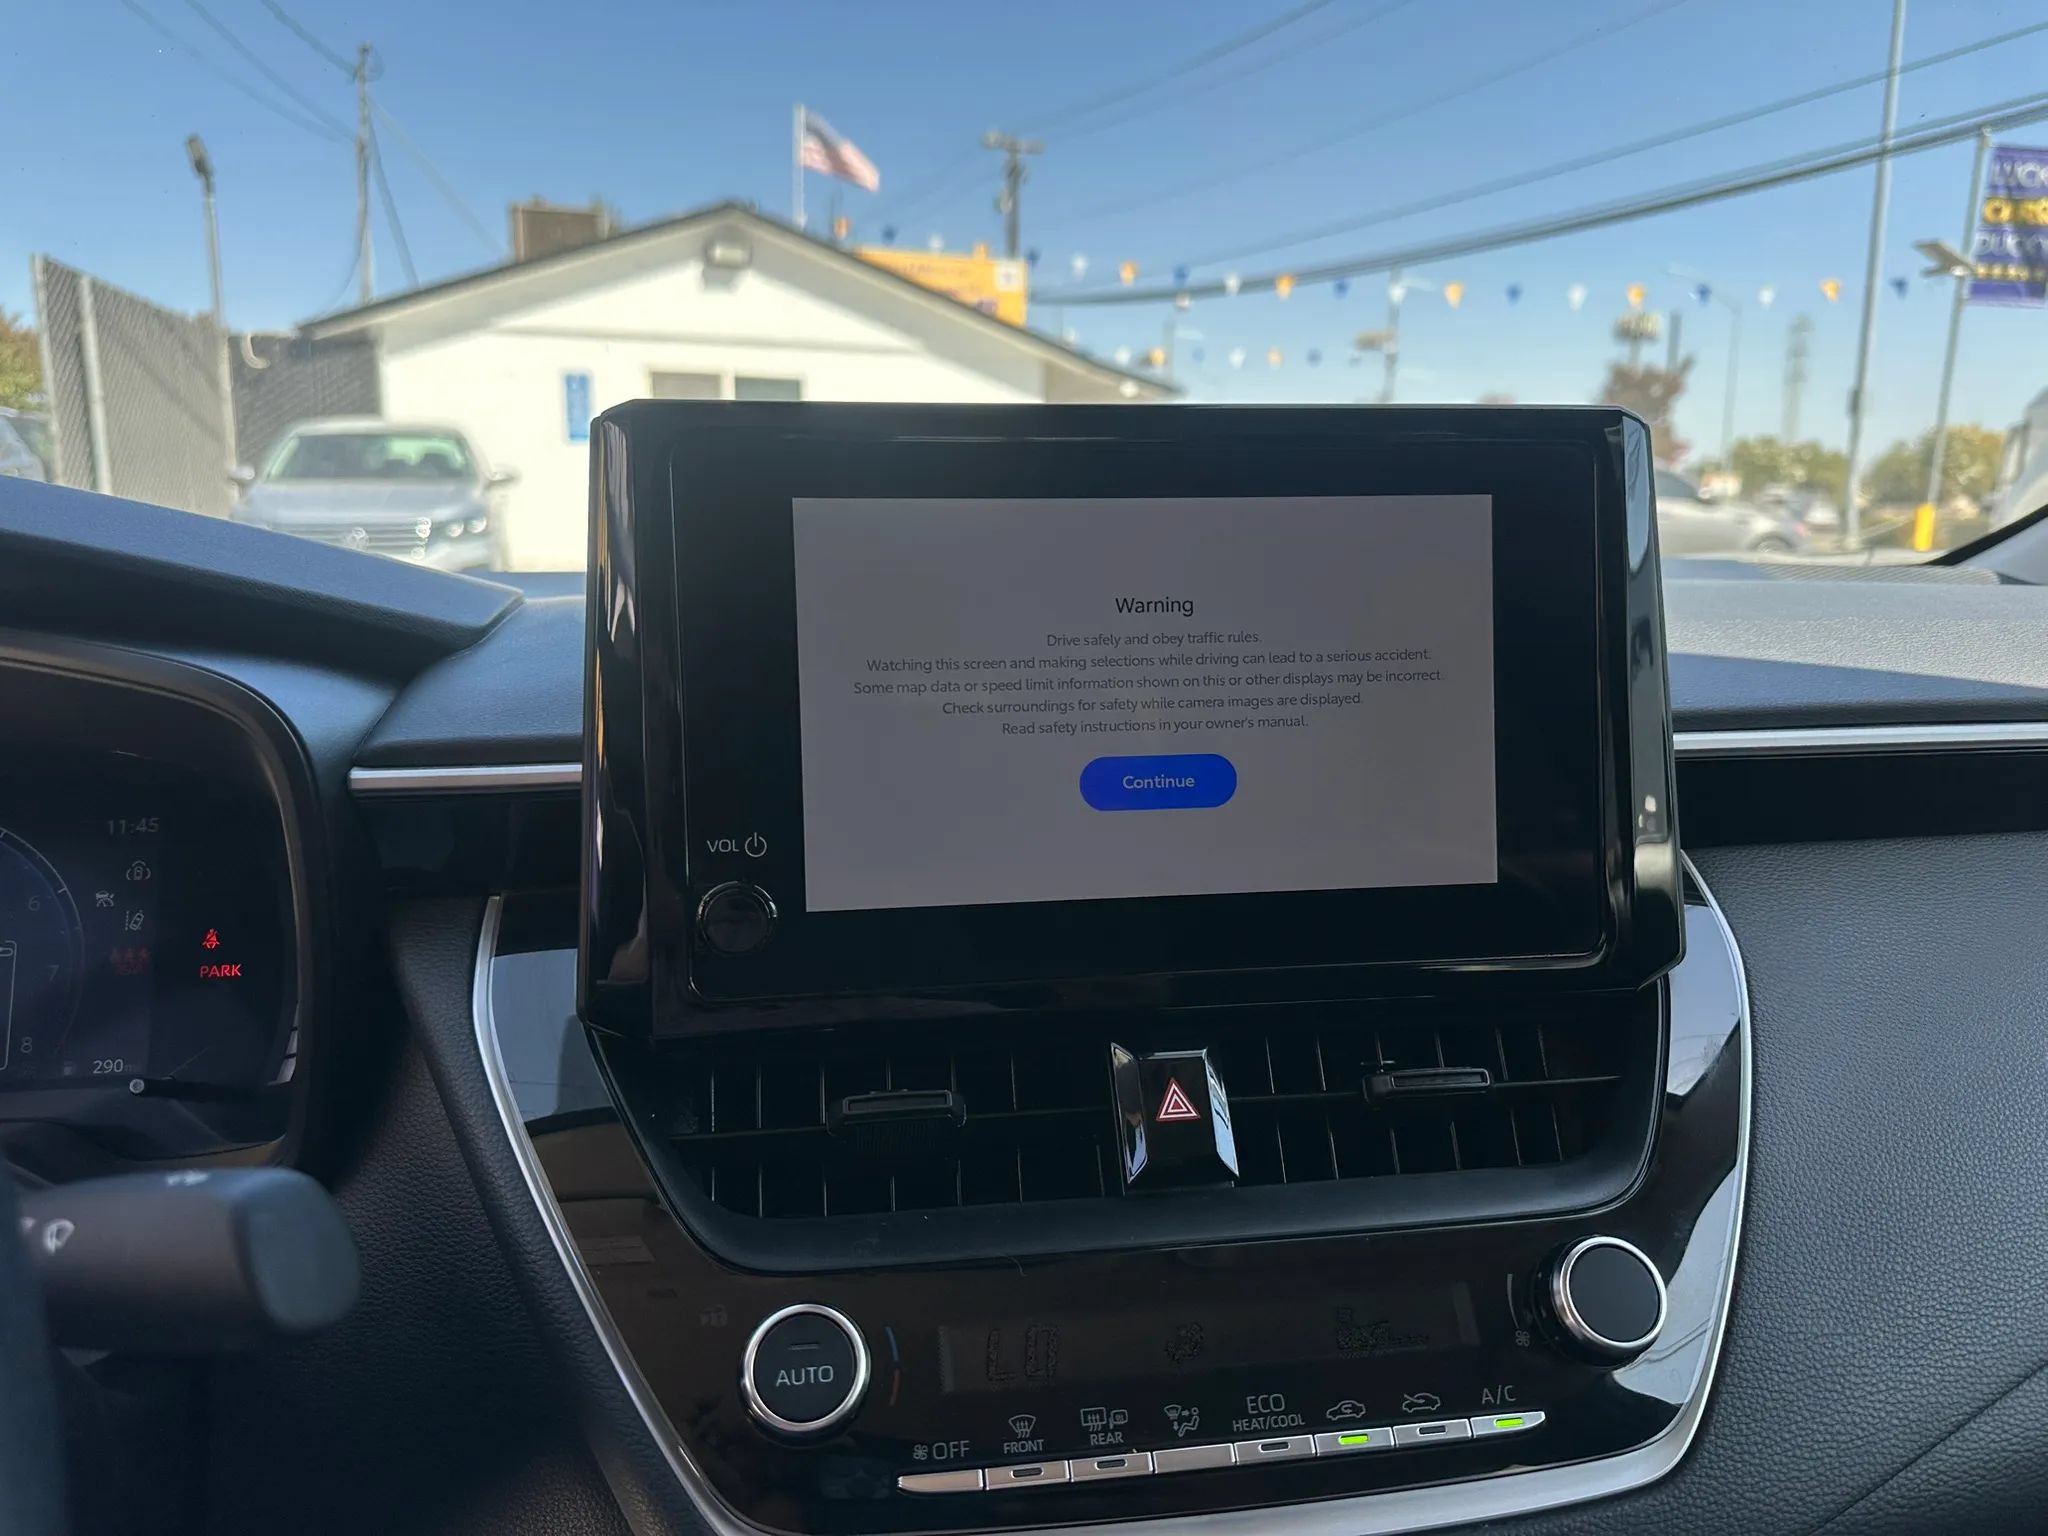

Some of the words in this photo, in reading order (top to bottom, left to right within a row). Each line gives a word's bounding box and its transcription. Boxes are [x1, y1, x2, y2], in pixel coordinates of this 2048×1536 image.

[1115, 596, 1195, 618] Warning
[1047, 634, 1081, 647] Drive
[1083, 633, 1121, 649] safely
[1125, 633, 1149, 646] and
[1152, 632, 1184, 648] obey
[1187, 631, 1225, 644] traffic
[1228, 630, 1262, 643] rules.
[866, 659, 932, 674] Watching
[936, 658, 960, 671] this
[963, 659, 1006, 670] screen
[1010, 657, 1035, 670] and
[1038, 656, 1087, 671] making
[1090, 655, 1155, 668] selections
[1158, 653, 1193, 667] while
[1195, 652, 1239, 668] driving
[1242, 654, 1265, 665] can
[1268, 651, 1296, 664] lead
[1300, 651, 1313, 664] to
[1316, 654, 1324, 663] a
[1327, 650, 1372, 663] serious
[1374, 648, 1431, 662] accident.
[854, 682, 894, 694] Some
[897, 683, 927, 696] map
[930, 680, 961, 693] data
[964, 682, 978, 692] or
[981, 679, 1022, 694] speed
[1025, 678, 1054, 691] limit
[1057, 677, 1133, 690] information
[1136, 676, 1179, 689] shown
[1182, 677, 1200, 687] on
[1203, 674, 1225, 687] this
[1228, 676, 1242, 686] or
[1246, 673, 1279, 686] other
[1282, 671, 1333, 687] displays
[1337, 673, 1363, 686] may
[1366, 670, 1382, 683] be
[942, 702, 984, 715] Check
[987, 700, 1075, 715] surroundings
[1078, 699, 1095, 712] for
[1099, 698, 1138, 714] safety
[1141, 698, 1174, 710] while
[1178, 698, 1224, 709] camera
[1228, 695, 1274, 710] images
[1277, 696, 1297, 706] are
[1002, 722, 1035, 735] Read
[1039, 721, 1077, 736] safety
[1080, 719, 1156, 733] instructions
[1159, 718, 1171, 731] in
[1173, 720, 1202, 733] your
[1205, 717, 1254, 730] owner's
[1257, 715, 1308, 729] manual.
[1122, 773, 1195, 790] Continue
[107, 817, 160, 835] 11:45
[706, 839, 740, 853] VOL
[27, 895, 41, 912] 6
[48, 964, 60, 982] 7
[200, 963, 242, 978] PARK
[20, 1036, 33, 1054] 8
[92, 1059, 124, 1074] 290
[775, 1364, 835, 1388] AUTO
[1481, 1384, 1518, 1405] A/C
[1246, 1394, 1286, 1415] ECO
[1232, 1414, 1306, 1433] HEAT/COOL
[1003, 1438, 1045, 1455] FRONT
[1089, 1431, 1124, 1447] REAR
[932, 1440, 971, 1461] OFF
